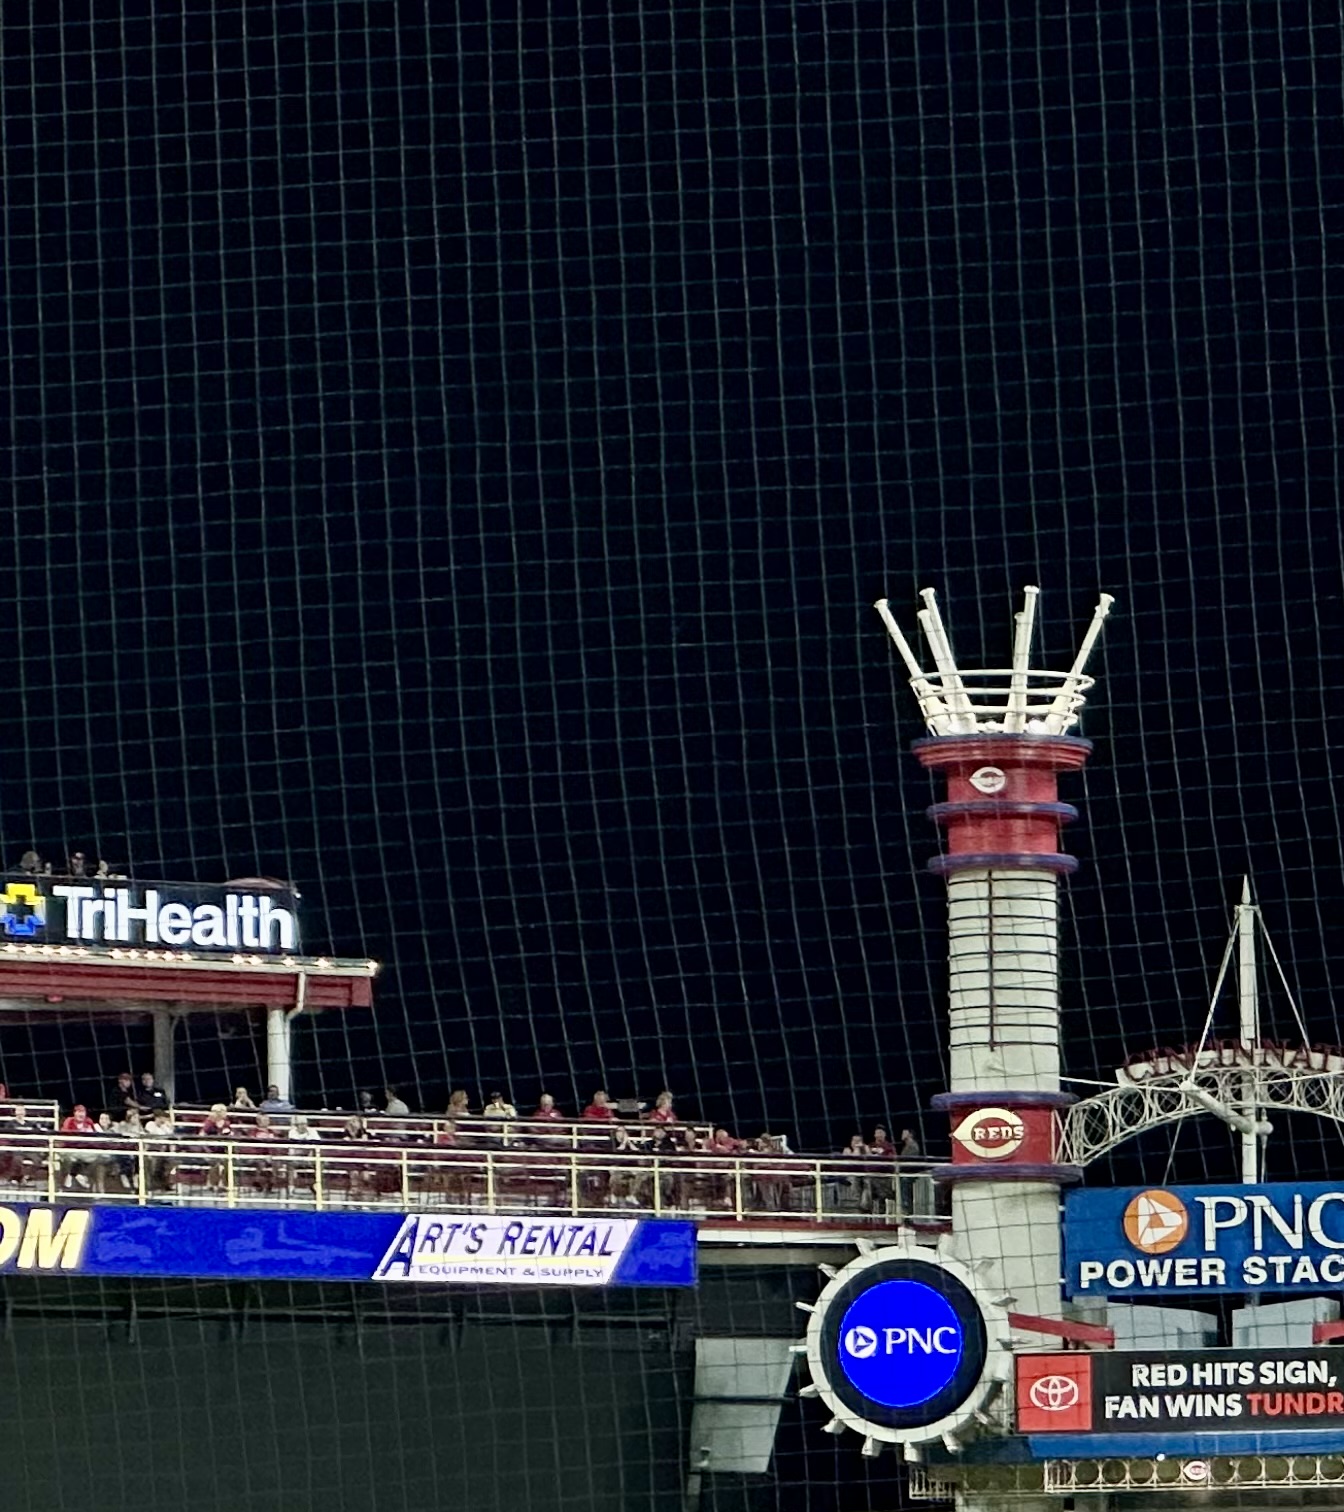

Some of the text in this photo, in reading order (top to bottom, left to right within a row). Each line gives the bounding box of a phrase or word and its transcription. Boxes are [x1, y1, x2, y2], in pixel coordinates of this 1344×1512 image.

[52, 885, 295, 949] TriHealth
[974, 1125, 1024, 1141] REDS
[380, 1217, 616, 1277] ART'S RENTAL
[418, 1265, 604, 1278] EQUIPMENT & SUPPLY
[1080, 1257, 1227, 1289] POWER
[882, 1326, 957, 1355] PNC
[1132, 1359, 1338, 1388] RED HITS SIGN,
[1104, 1395, 1160, 1420] FAN
[1164, 1393, 1243, 1418] WINS
